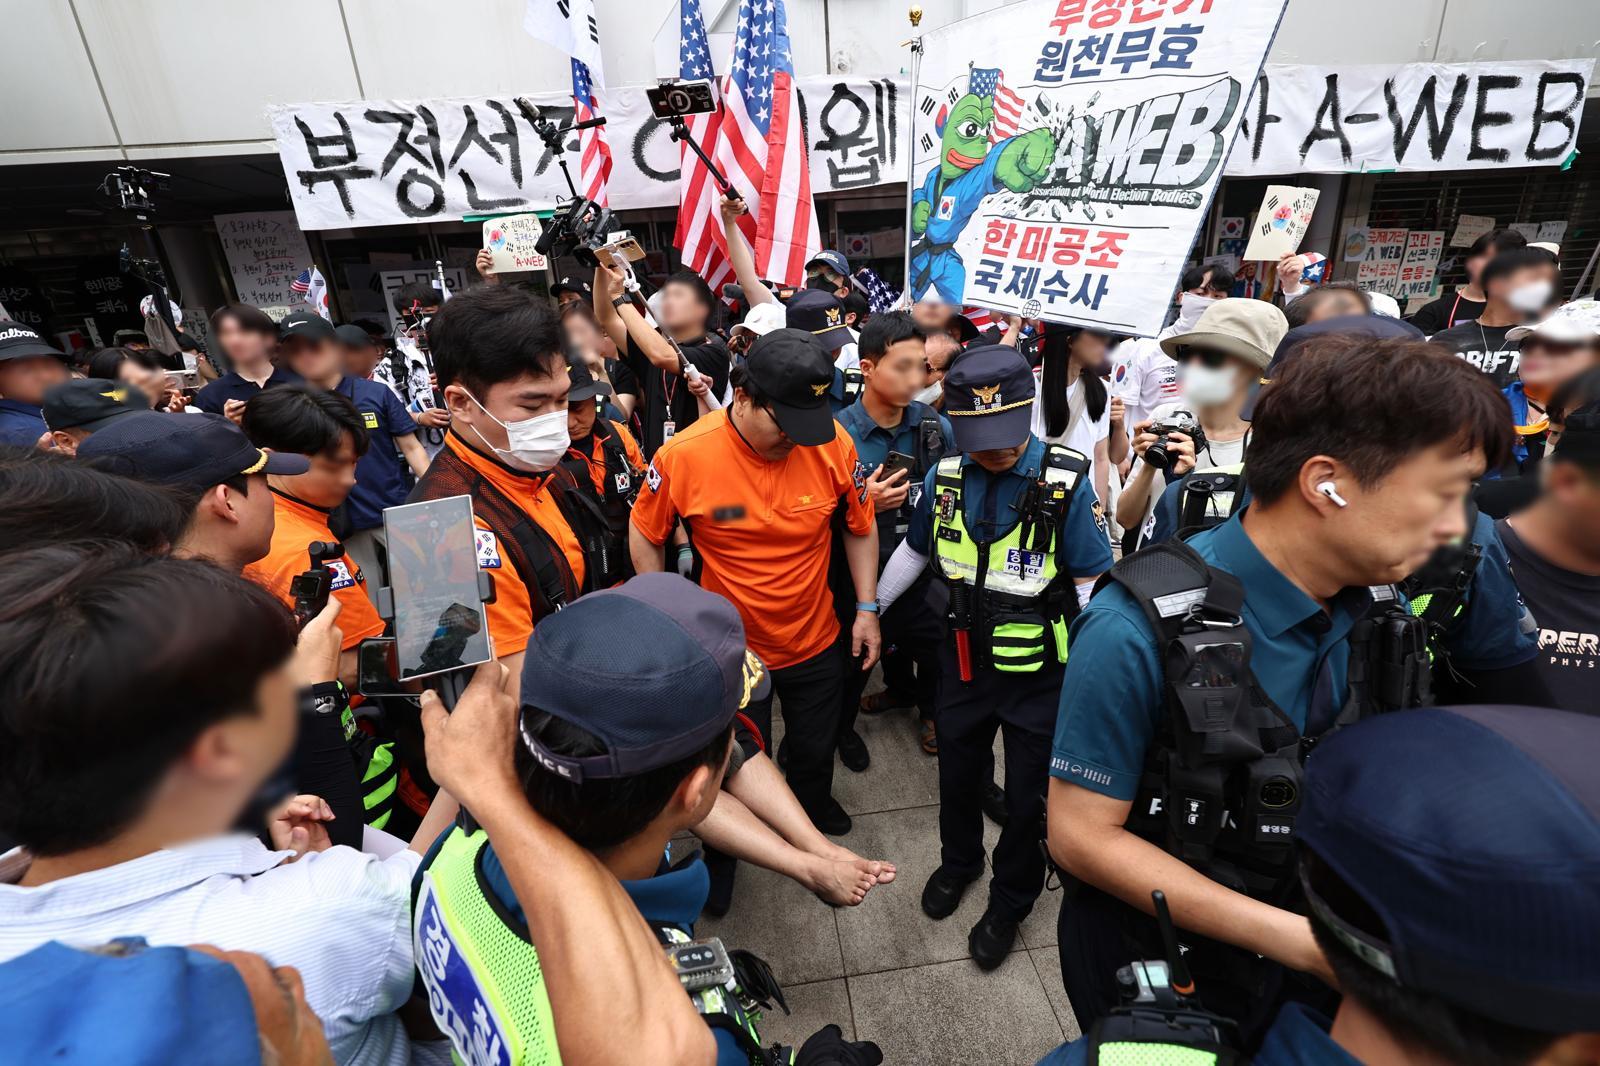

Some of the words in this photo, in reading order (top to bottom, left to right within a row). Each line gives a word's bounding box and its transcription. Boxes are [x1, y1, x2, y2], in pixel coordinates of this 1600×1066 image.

[1034, 23, 1205, 82] 원천무효
[1299, 72, 1585, 165] A-WEB
[1032, 185, 1070, 197] Association
[1072, 187, 1081, 197] of
[1082, 187, 1110, 200] World
[1110, 188, 1149, 202] Election
[1151, 189, 1198, 205] Bodies
[511, 218, 538, 233] 한미공조
[982, 219, 1130, 269] 한미공조
[1368, 231, 1405, 244] 국제기관
[1409, 233, 1430, 248] 꼬리
[1380, 245, 1402, 260] WEB
[1407, 248, 1440, 263] 선관위
[1359, 263, 1398, 278] 한미공조
[974, 259, 1109, 311] 국제수사
[1358, 279, 1395, 292] 국제수사
[1409, 281, 1432, 294] WEB
[251, 289, 283, 304] 부정선거
[0, 328, 38, 341] albon
[1007, 564, 1039, 575] POICE
